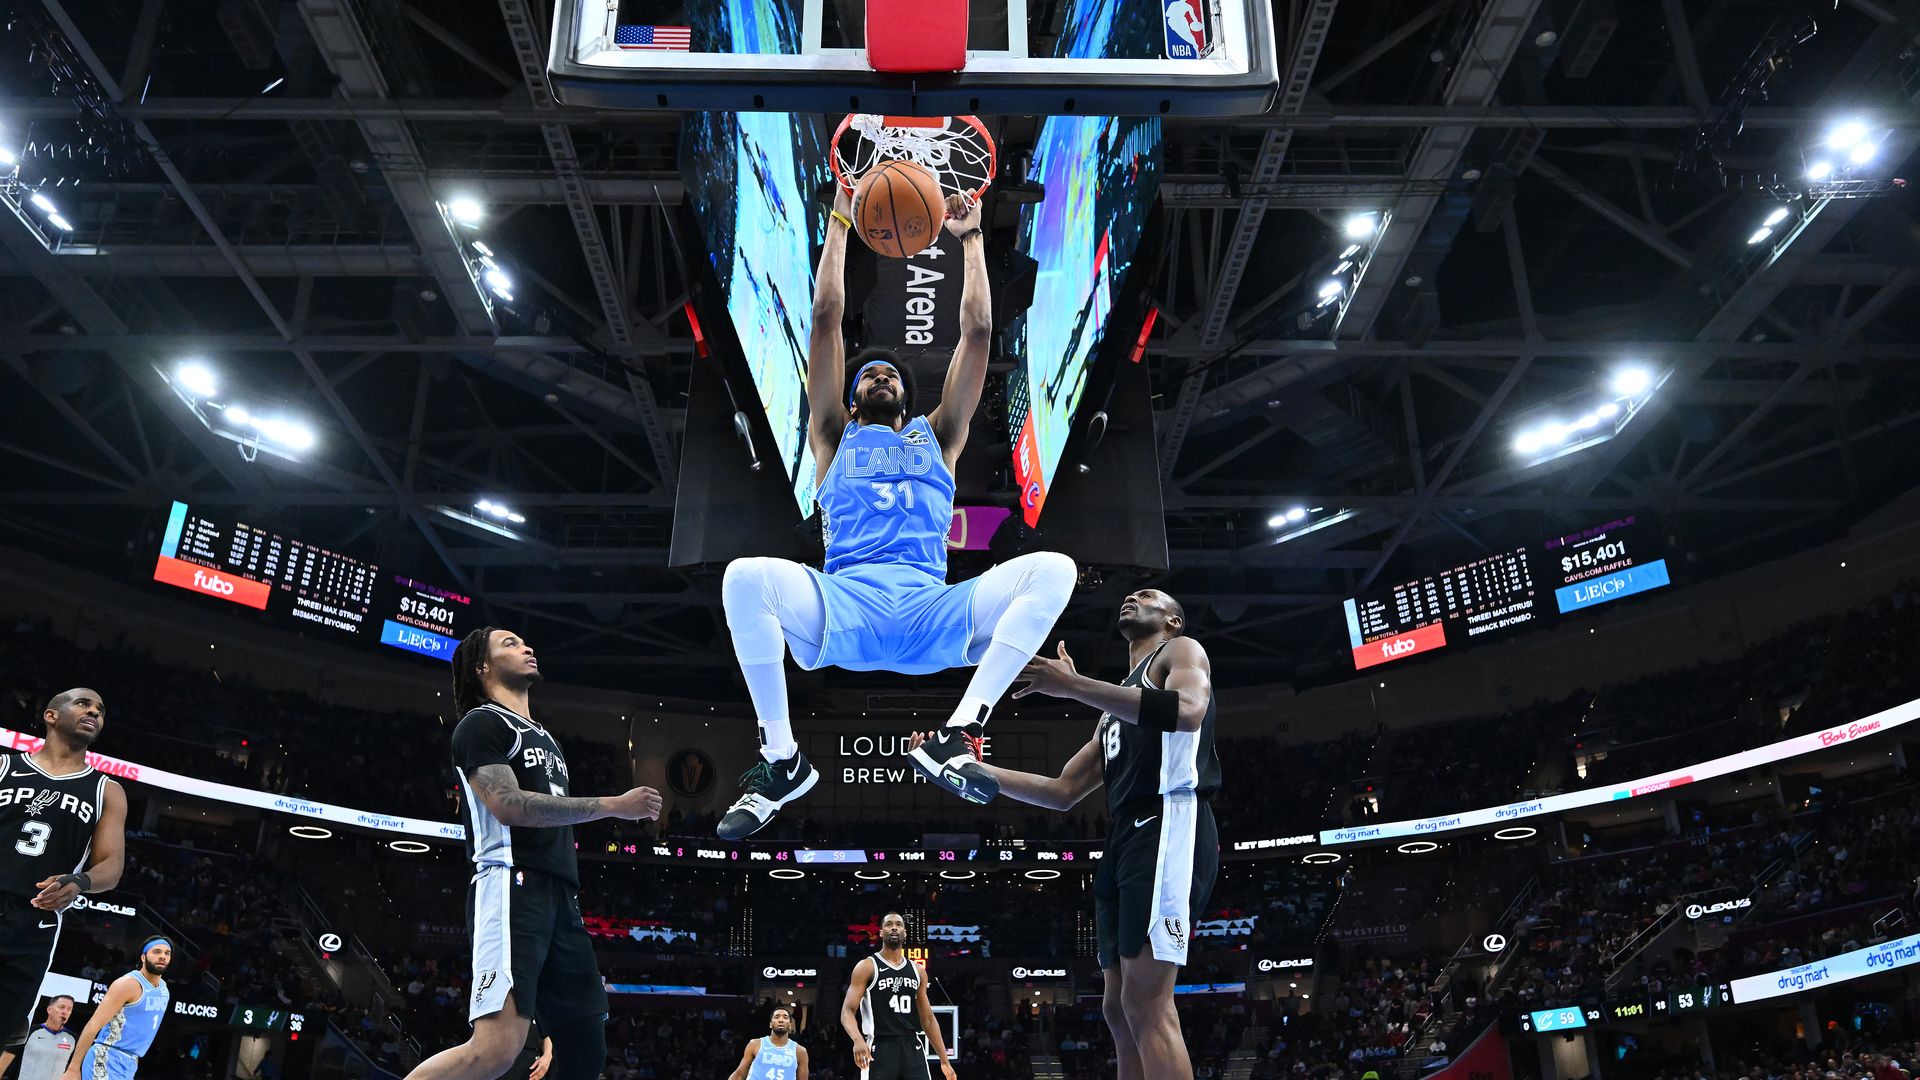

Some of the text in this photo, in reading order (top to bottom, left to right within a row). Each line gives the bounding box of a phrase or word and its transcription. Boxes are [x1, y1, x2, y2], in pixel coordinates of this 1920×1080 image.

[1172, 44, 1192, 56] NBA
[905, 264, 944, 344] Arena
[846, 446, 932, 478] LAND
[872, 480, 914, 510] 31
[1562, 540, 1626, 572] $15,401
[194, 570, 234, 596] fubo
[322, 604, 338, 615] MAX
[400, 596, 454, 624] $15,401
[1492, 607, 1508, 617] MAX
[292, 608, 356, 632] BISMACK BIYOMBO
[1468, 613, 1532, 636] BISMACK BIYOMBO
[1366, 634, 1379, 643] TEAM
[1380, 630, 1398, 638] TOTALS
[1382, 639, 1415, 657] fubo
[1818, 720, 1881, 746] Bob Evans
[86, 752, 140, 780] vans
[843, 768, 906, 784] BREW
[1636, 781, 1670, 796] DISCOUNT
[274, 799, 298, 812] drug
[300, 804, 324, 814] mart
[1496, 808, 1518, 818] drug
[1520, 802, 1542, 814] mart
[358, 813, 380, 826] drug
[381, 818, 404, 828] mart
[1414, 822, 1437, 831] drug
[1438, 818, 1461, 828] mart
[15, 820, 52, 856] 3
[440, 826, 462, 838] drug
[1334, 832, 1356, 841] drug
[1358, 828, 1380, 838] mart
[624, 844, 636, 854] +6
[676, 848, 683, 857] 5
[698, 849, 726, 860] FOULS
[732, 851, 738, 860] 0
[776, 852, 788, 860] 45
[834, 852, 846, 860] 59
[899, 852, 925, 860] 11:01
[938, 851, 955, 861] 3Q
[1000, 851, 1012, 860] 53
[1062, 852, 1074, 860] 36
[88, 900, 136, 916] LEXUS
[1702, 898, 1751, 914] LEXUS
[1880, 940, 1904, 950] DISCOUNT
[1273, 958, 1314, 968] LEXUS
[1866, 952, 1894, 967] drug
[777, 968, 816, 976] LEXUS
[1778, 966, 1829, 988] drug mart
[174, 1001, 218, 1018] BLOCKS
[889, 995, 912, 1013] 40
[1524, 1022, 1530, 1030] 0
[1560, 1012, 1575, 1025] 59
[1615, 1004, 1644, 1018] 11:01
[1656, 1001, 1666, 1010] 18
[1678, 994, 1694, 1008] 53
[1722, 992, 1728, 1002] 0
[152, 1014, 158, 1030] 1
[244, 1010, 253, 1024] 3
[290, 1021, 302, 1031] 36
[762, 1052, 793, 1068] LAND
[766, 1068, 784, 1080] 45
